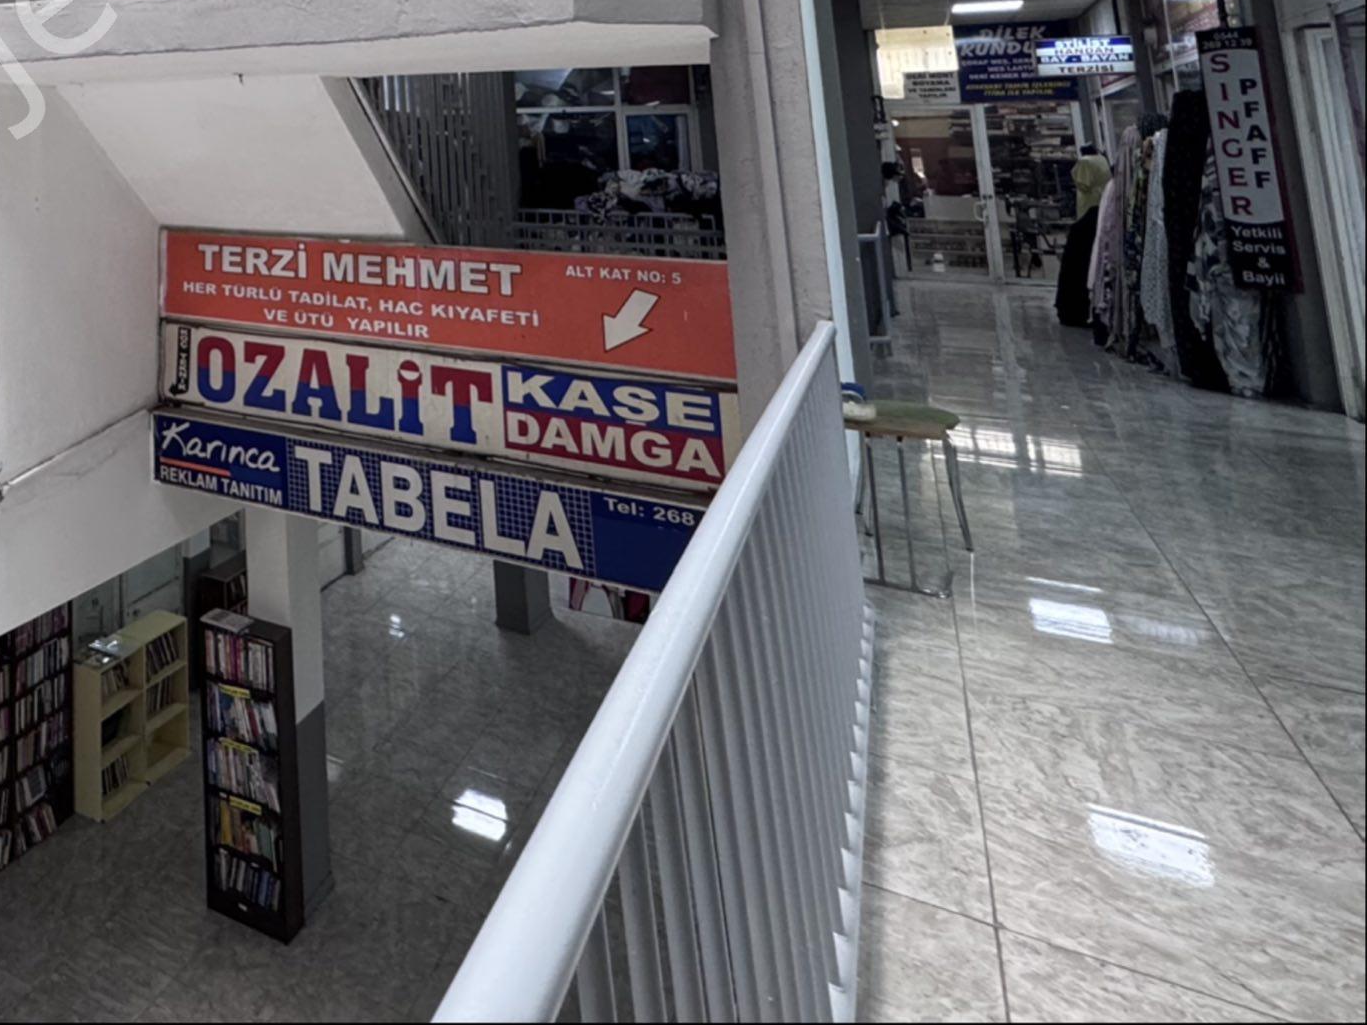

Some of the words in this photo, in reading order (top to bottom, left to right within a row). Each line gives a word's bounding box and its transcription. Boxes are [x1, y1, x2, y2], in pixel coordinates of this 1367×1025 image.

[960, 41, 1034, 57] KUNDU
[1210, 53, 1253, 215] SINGER
[1239, 78, 1271, 189] PFAFF
[1231, 226, 1282, 239] Yetkili
[1232, 241, 1285, 255] Servis
[198, 243, 307, 278] TERZİ
[323, 252, 522, 296] MEHMET
[565, 265, 594, 278] ALT
[599, 267, 631, 281] KAT
[637, 270, 666, 284] NO:
[671, 272, 682, 285] 5
[183, 281, 217, 295] HER
[222, 284, 282, 301] TÜRLÜ
[288, 290, 372, 313] TADİLAT,
[379, 299, 423, 315] HAC
[431, 304, 539, 327] KIYAFETİ
[263, 308, 288, 322] VE
[294, 310, 333, 327] ÜTÜ
[347, 317, 430, 338] YAPILIR
[506, 371, 715, 432] KAŞE
[505, 410, 722, 477] DAMGA
[159, 465, 218, 490] REKLAM
[221, 478, 283, 506] TANITIM
[294, 445, 584, 570] TABELA
[603, 496, 645, 517] Tel:
[652, 506, 696, 526] 268
